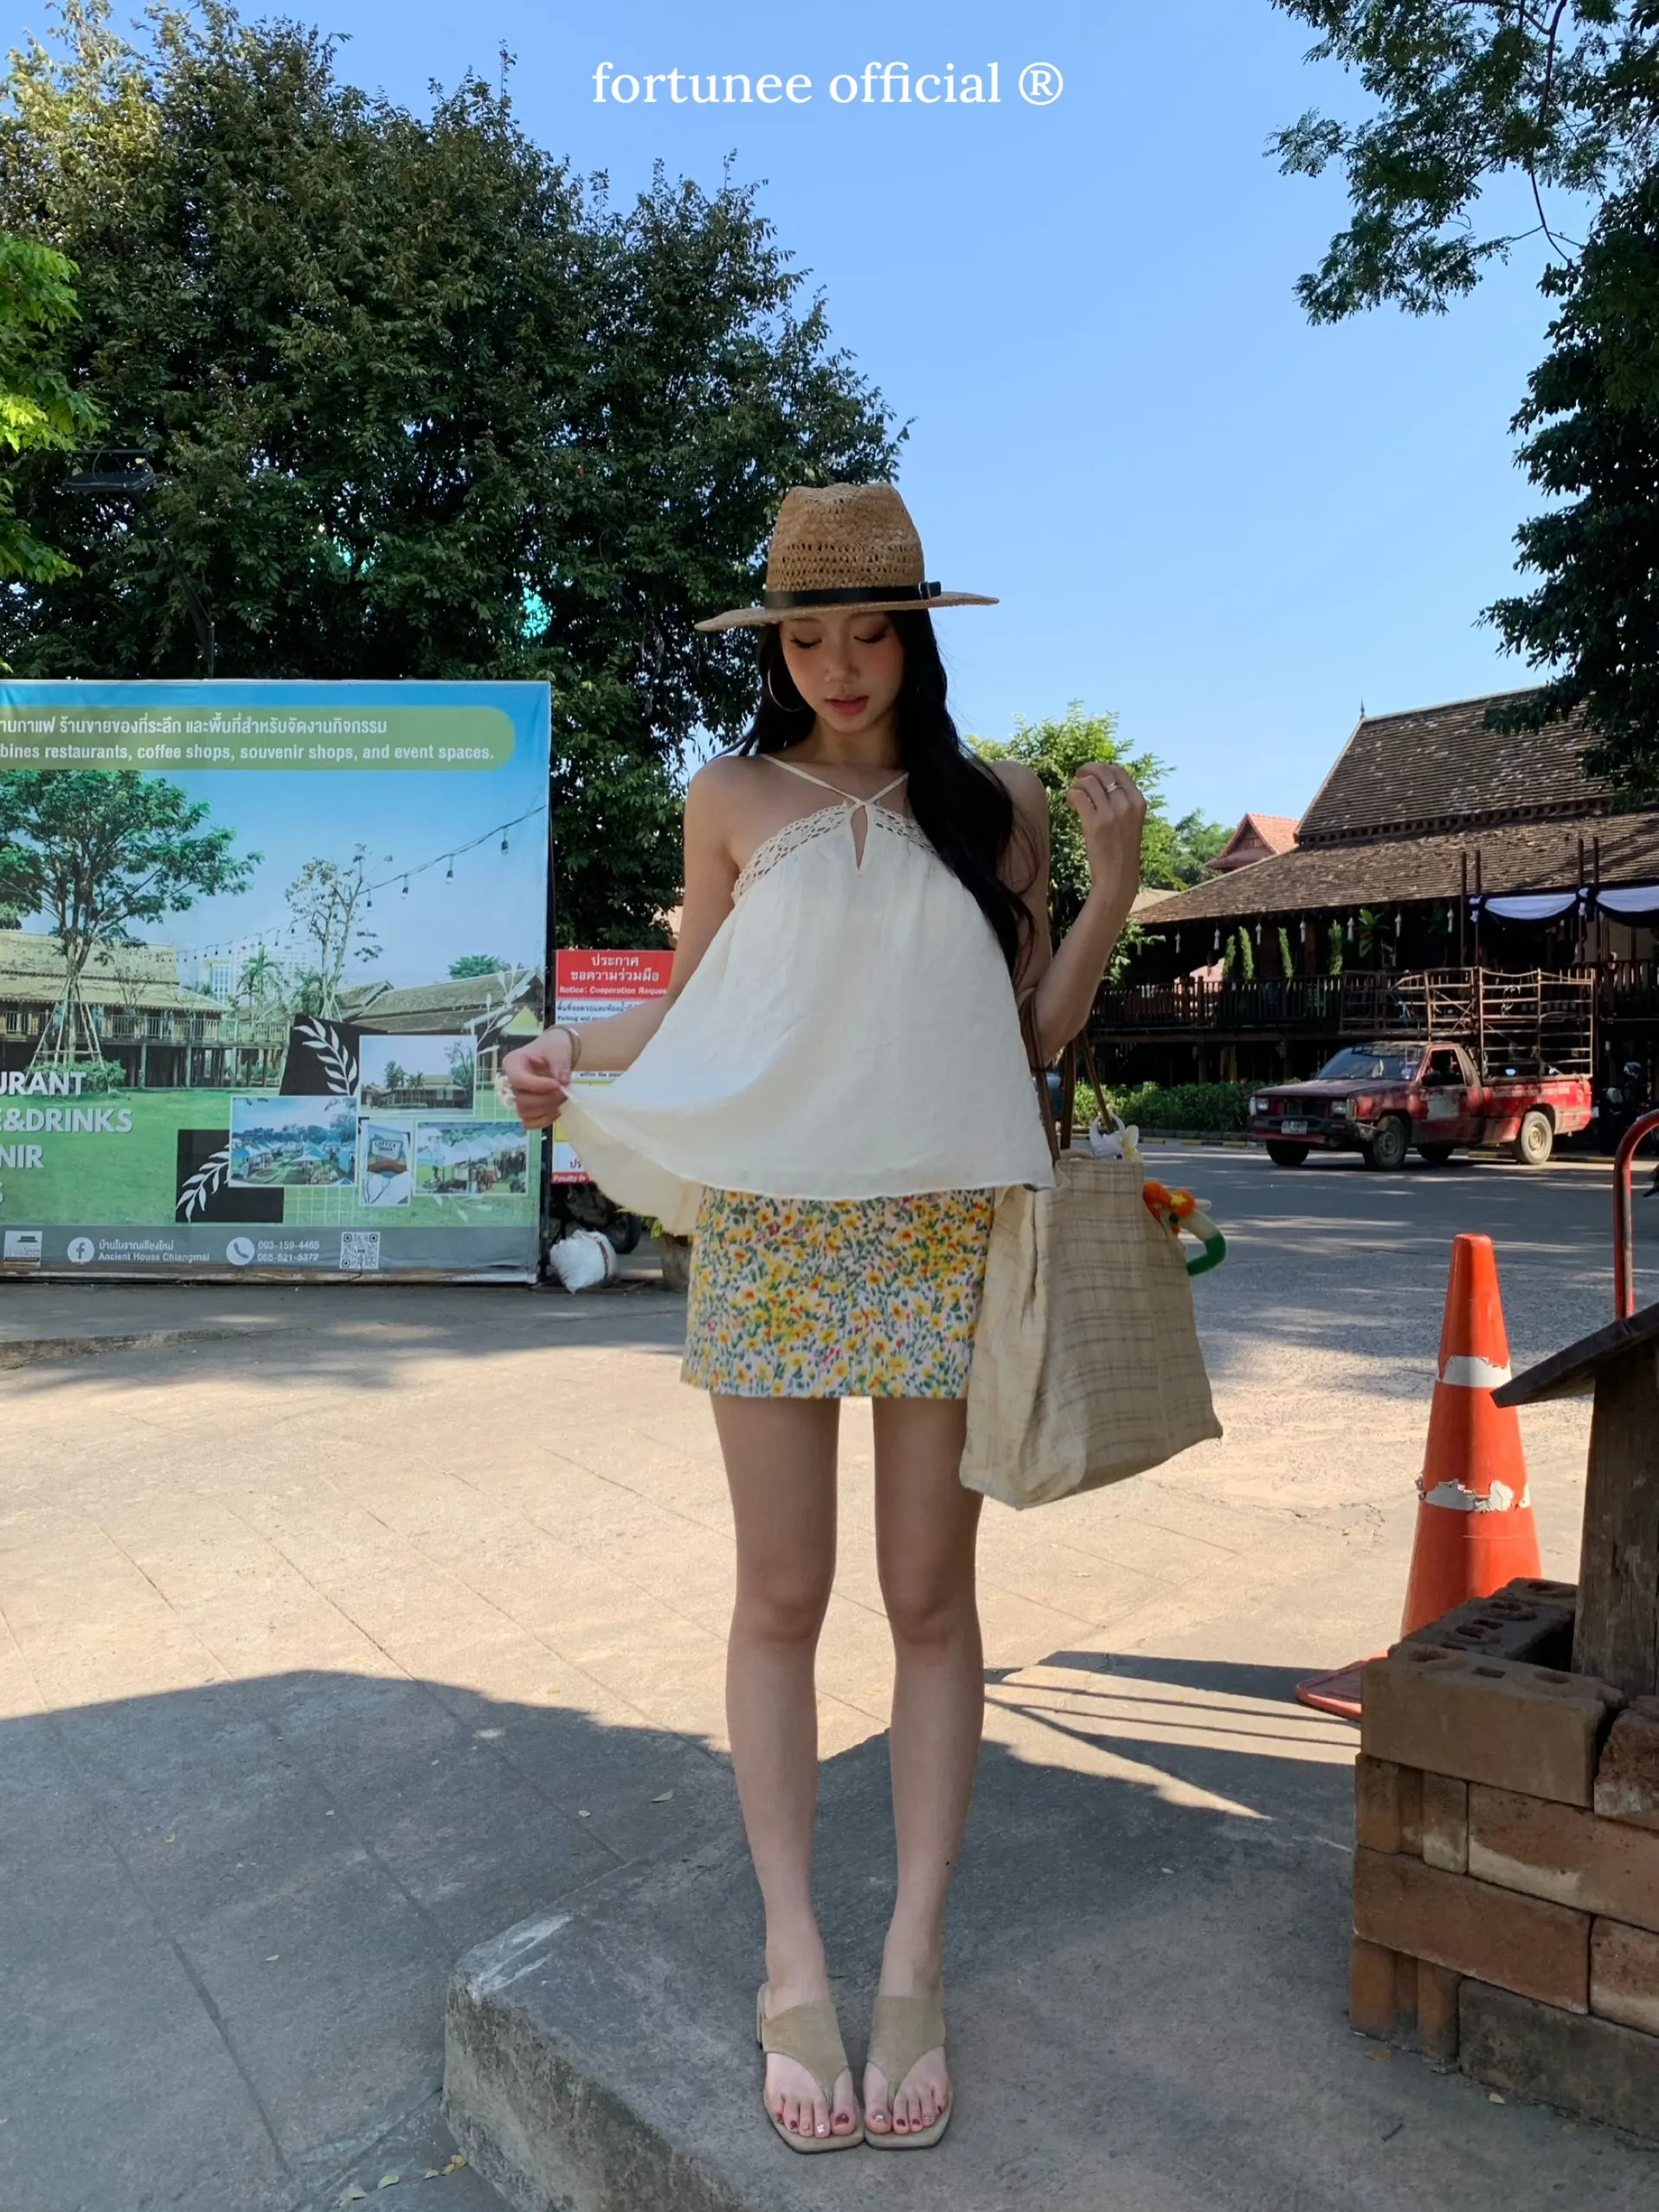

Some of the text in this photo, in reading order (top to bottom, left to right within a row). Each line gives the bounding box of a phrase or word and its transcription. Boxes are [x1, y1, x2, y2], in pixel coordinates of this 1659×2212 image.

[60, 713, 181, 733] ร้านขายของที่ระลึก
[186, 711, 387, 734] และพื้นที่สำหรับจัดงานกิจกรรม
[45, 744, 132, 761] restaurants,
[137, 743, 181, 759] coffee
[186, 743, 235, 762] shops,
[240, 744, 304, 759] souvenir
[309, 744, 358, 762] shops,
[363, 744, 389, 759] and
[395, 745, 433, 759] event
[439, 746, 494, 762] spaces.
[591, 954, 640, 967] ประกาศ
[589, 987, 636, 995] Cooperation
[0, 1108, 134, 1133] &DRINKS
[98, 1252, 131, 1261] Ancient
[133, 1252, 161, 1261] House
